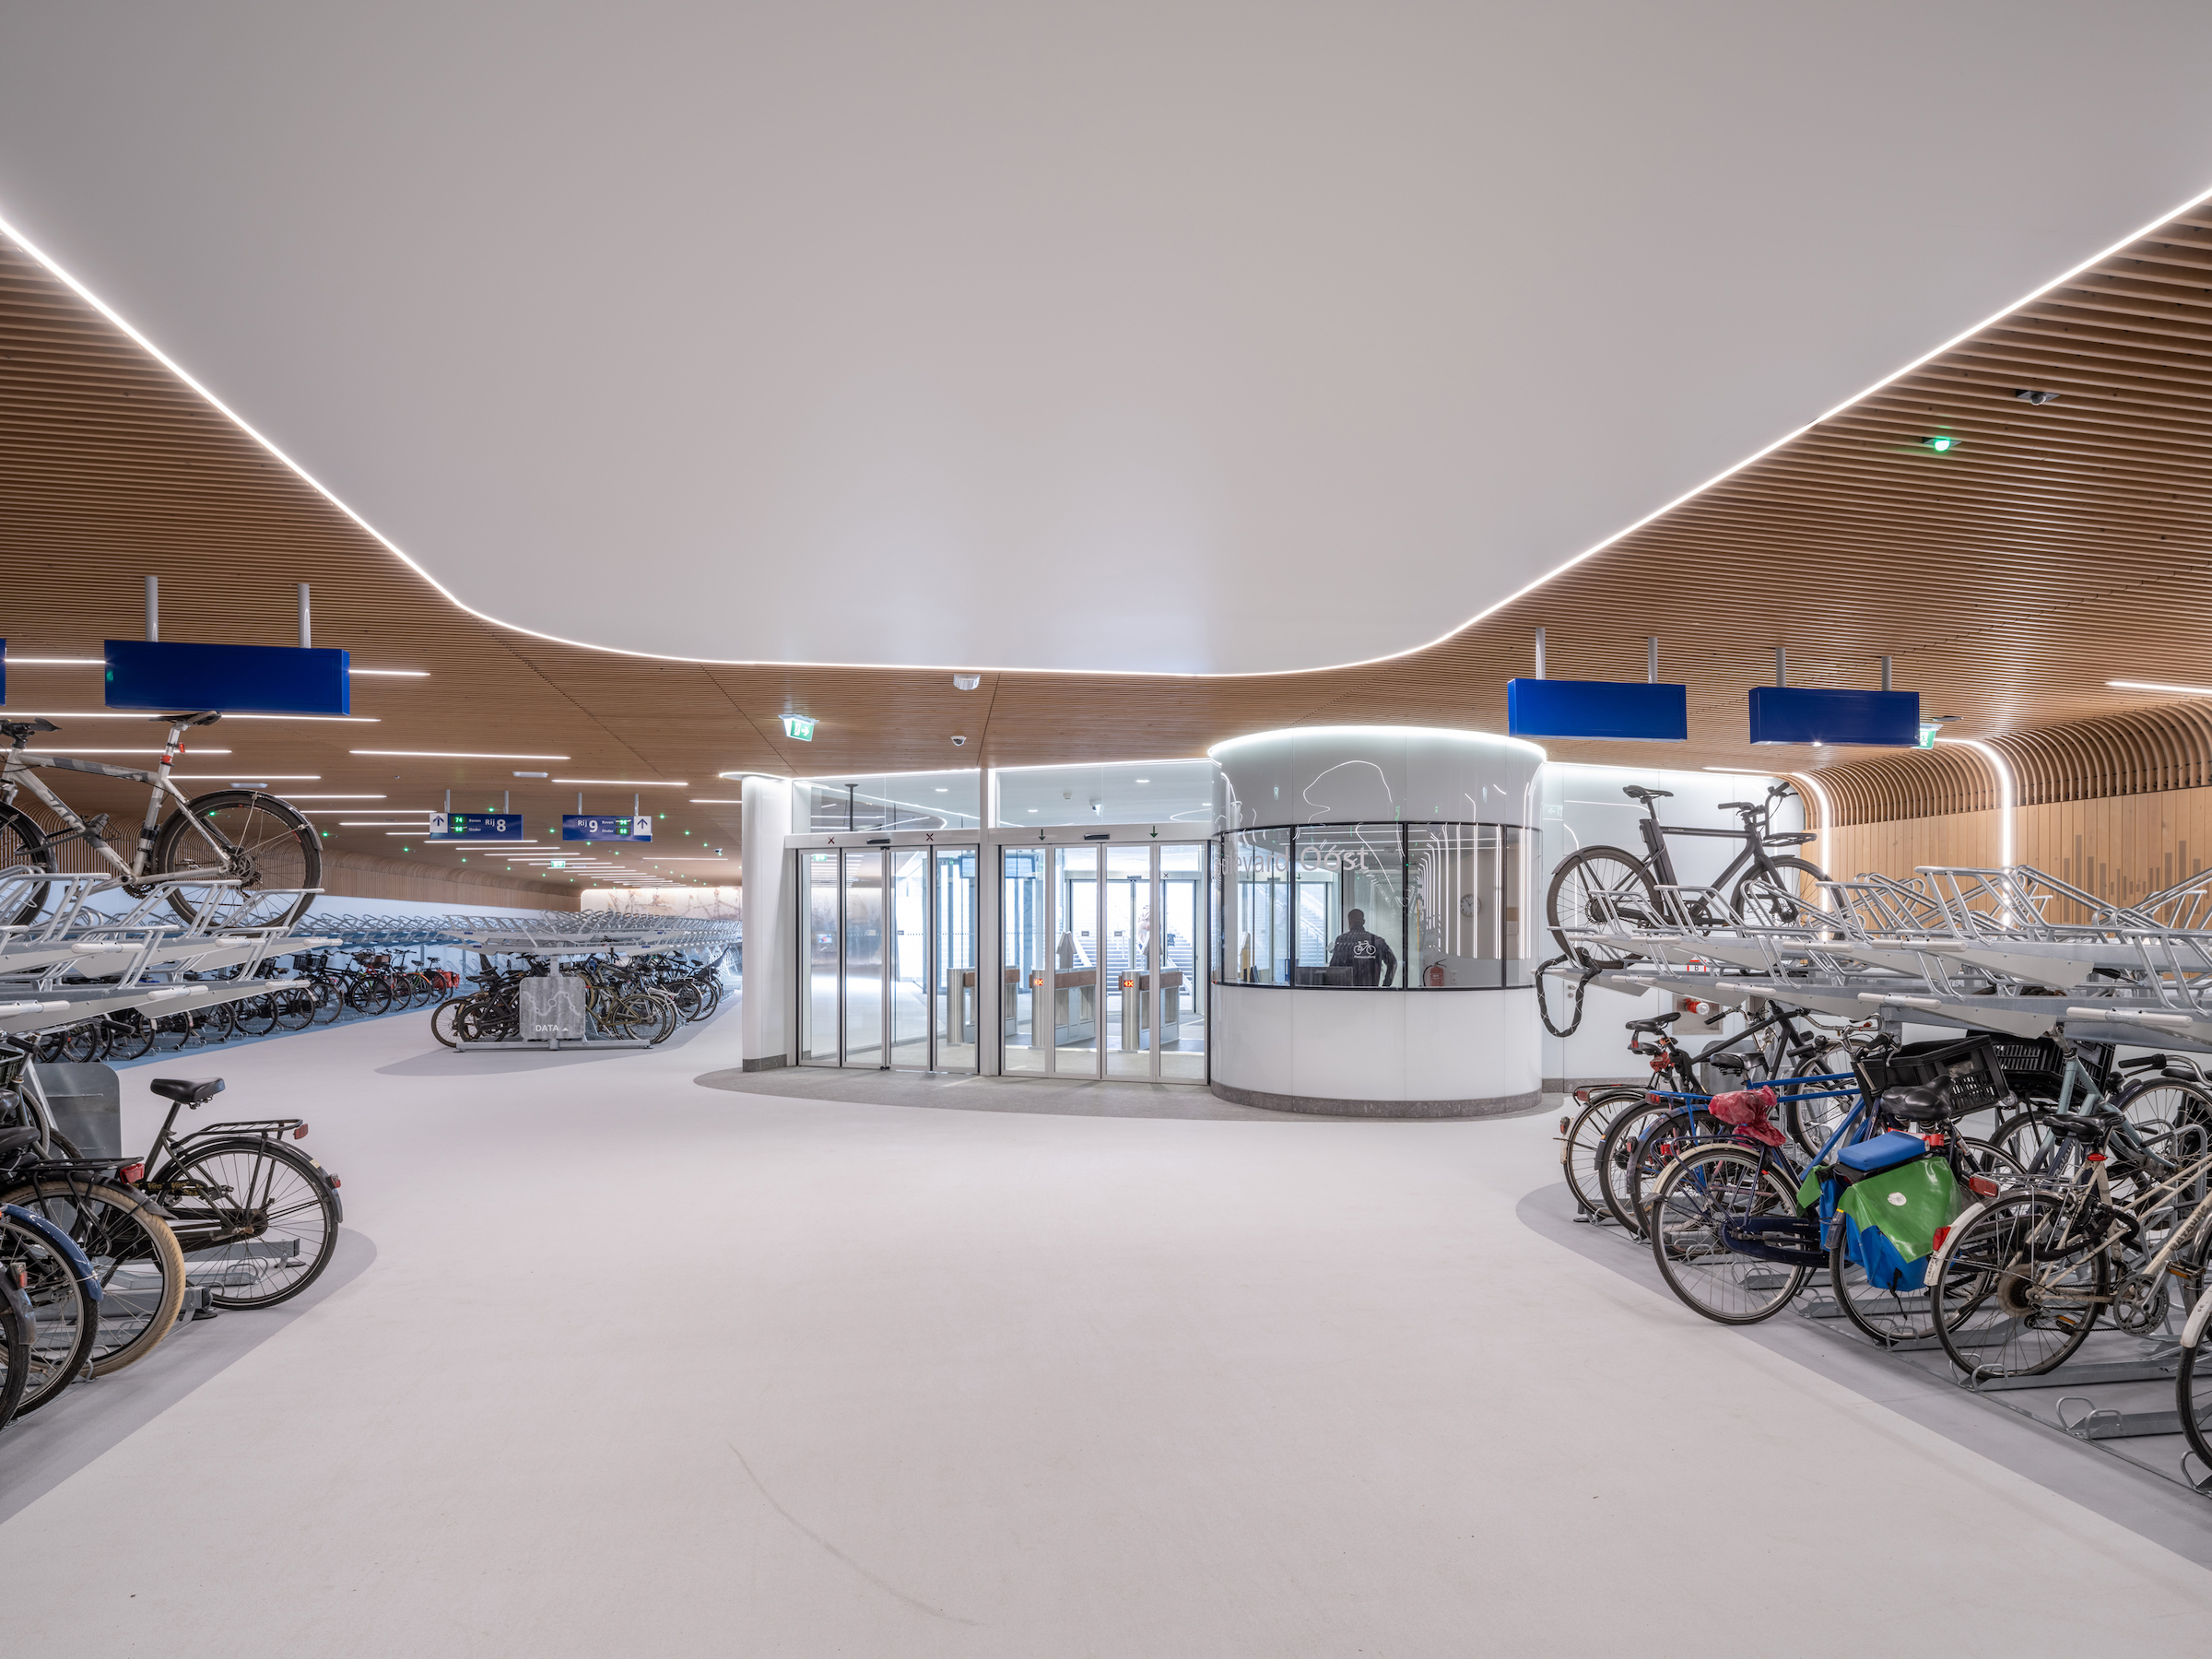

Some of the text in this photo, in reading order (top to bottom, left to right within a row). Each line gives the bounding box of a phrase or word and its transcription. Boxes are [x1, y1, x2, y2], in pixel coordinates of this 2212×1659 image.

[485, 818, 506, 832] Rij 8
[577, 819, 598, 833] Rij 9
[1215, 845, 1370, 876] ulevard Oost
[535, 1024, 559, 1032] DATA
[2169, 1205, 2209, 1252] BATAVUS
